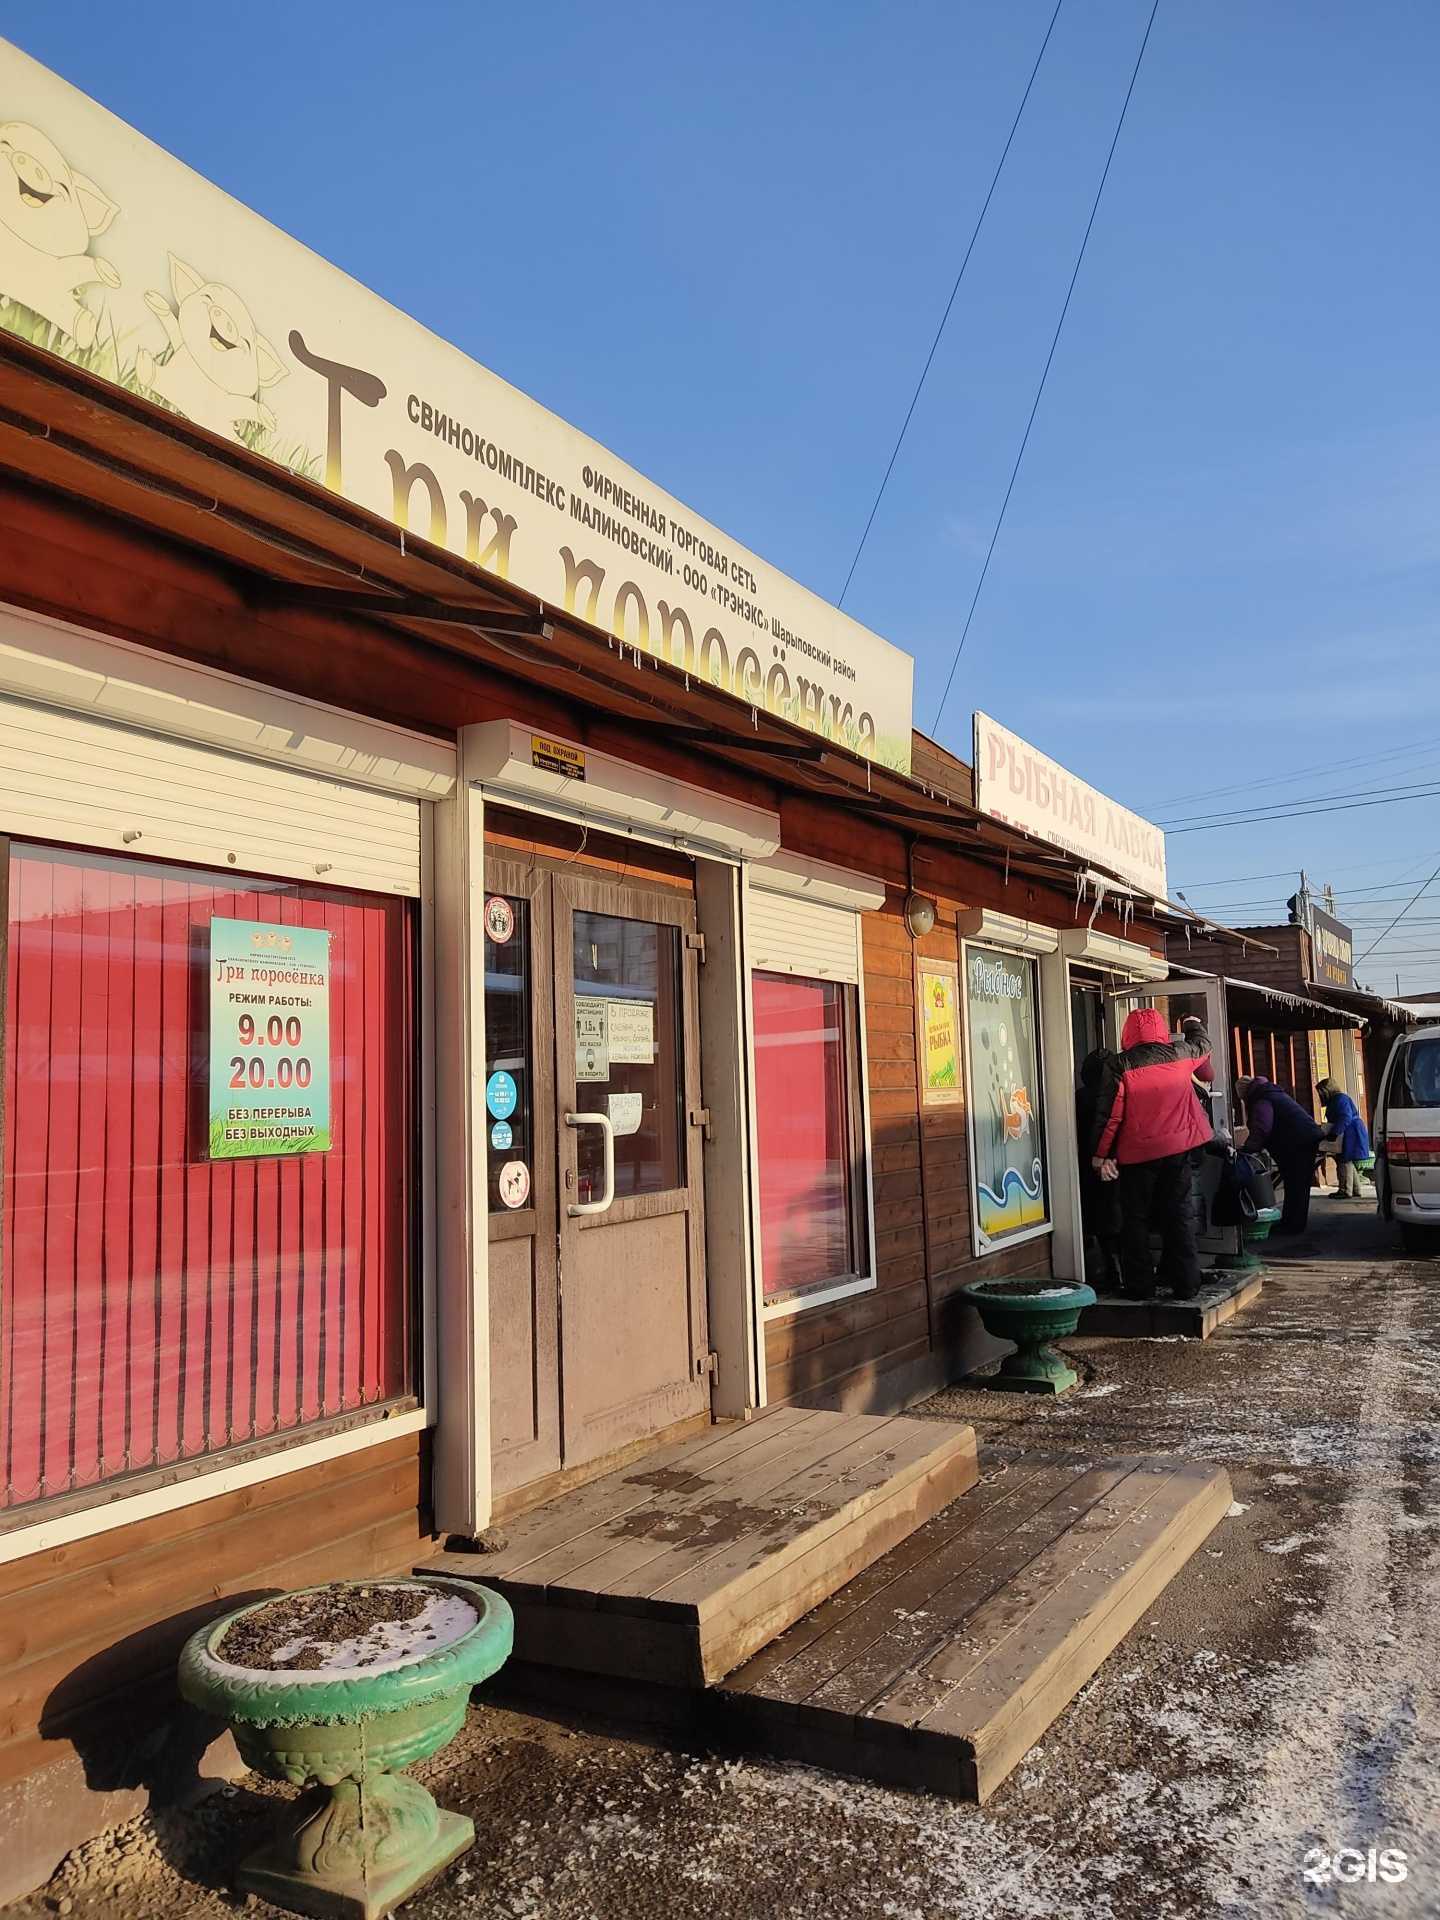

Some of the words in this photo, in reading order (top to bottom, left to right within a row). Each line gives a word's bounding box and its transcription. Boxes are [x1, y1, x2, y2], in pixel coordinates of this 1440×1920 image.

[288, 329, 518, 587] Три
[407, 394, 566, 511] СВИНОКОМПЛЕКС
[570, 493, 673, 576] МАЛИНОВСКИЙ
[683, 564, 708, 596] ООО
[711, 584, 769, 632] «ТРЭНЭКС»
[771, 616, 831, 667] Шарыповский
[833, 659, 856, 683] район
[582, 465, 666, 537] ФИРМЕННАЯ
[669, 520, 728, 576] ТОРГОВАЯ
[731, 561, 757, 594] СЕТЬ
[988, 733, 1096, 837] РЫБНАЯ
[1105, 806, 1163, 872] ЛАВКА
[215, 959, 245, 984] Три
[251, 967, 325, 987] поросёнка
[974, 956, 1022, 1000] Рыбное
[229, 993, 266, 1005] РЕЖИМ
[268, 995, 312, 1008] РАБОТЫ:
[238, 1013, 302, 1046] 9.00
[229, 1056, 312, 1089] 20.00
[228, 1109, 249, 1120] БЕЗ
[252, 1107, 312, 1120] ПЕРЕРЫВА
[225, 1128, 247, 1140] БЕЗ
[250, 1126, 314, 1139] ВЫХОДНЫХ
